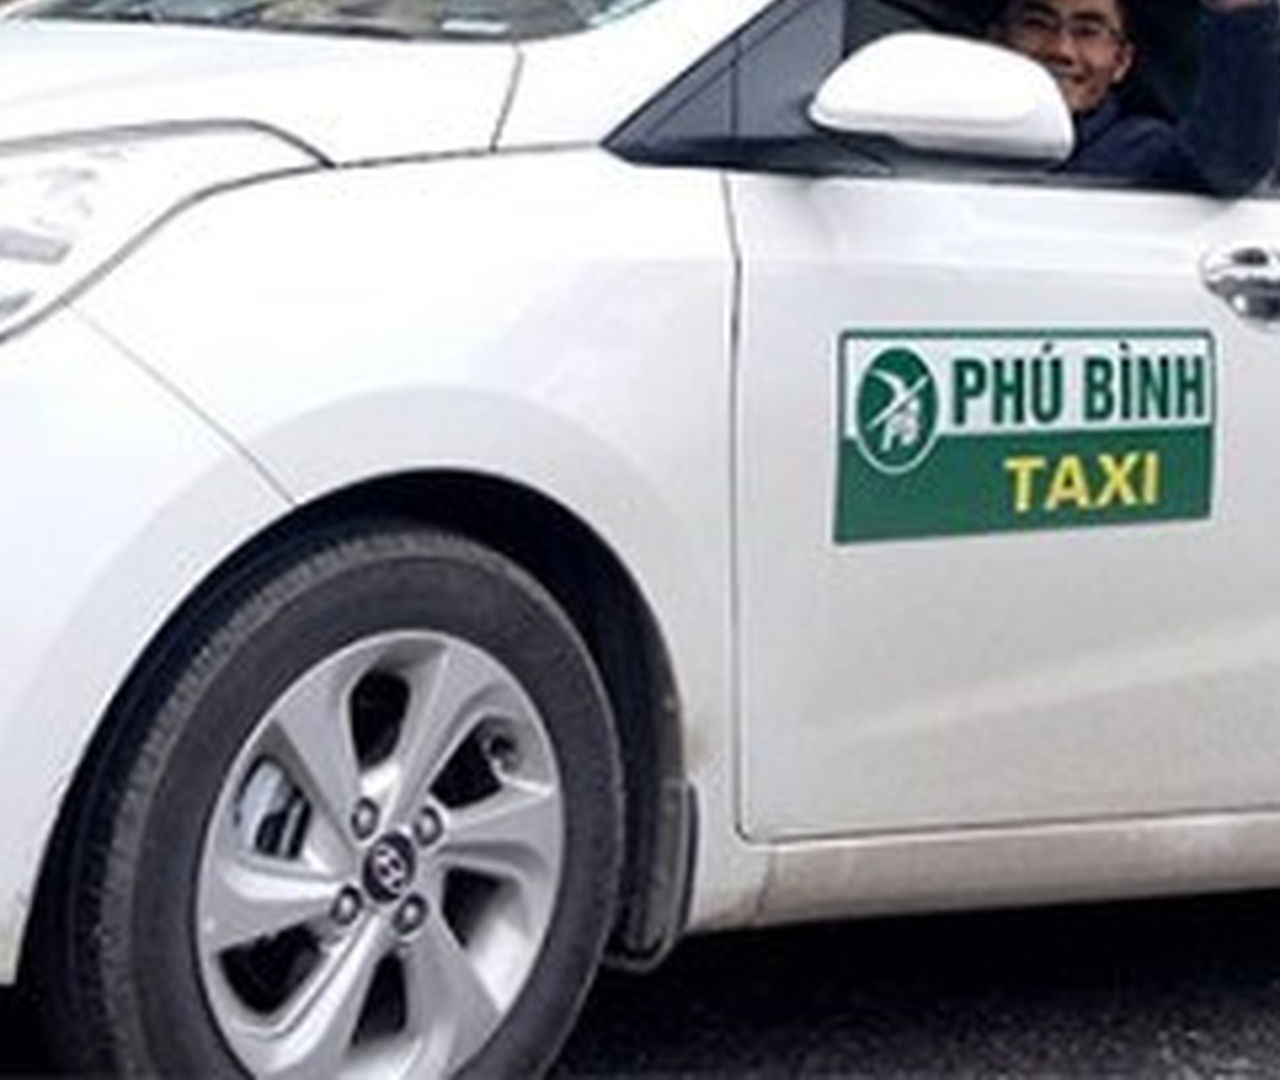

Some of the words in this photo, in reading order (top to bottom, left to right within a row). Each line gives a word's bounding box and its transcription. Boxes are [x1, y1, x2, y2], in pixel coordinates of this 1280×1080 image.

[951, 342, 1063, 426] PHÚ
[1082, 340, 1206, 420] BÌNH
[1002, 449, 1161, 513] TAXI
